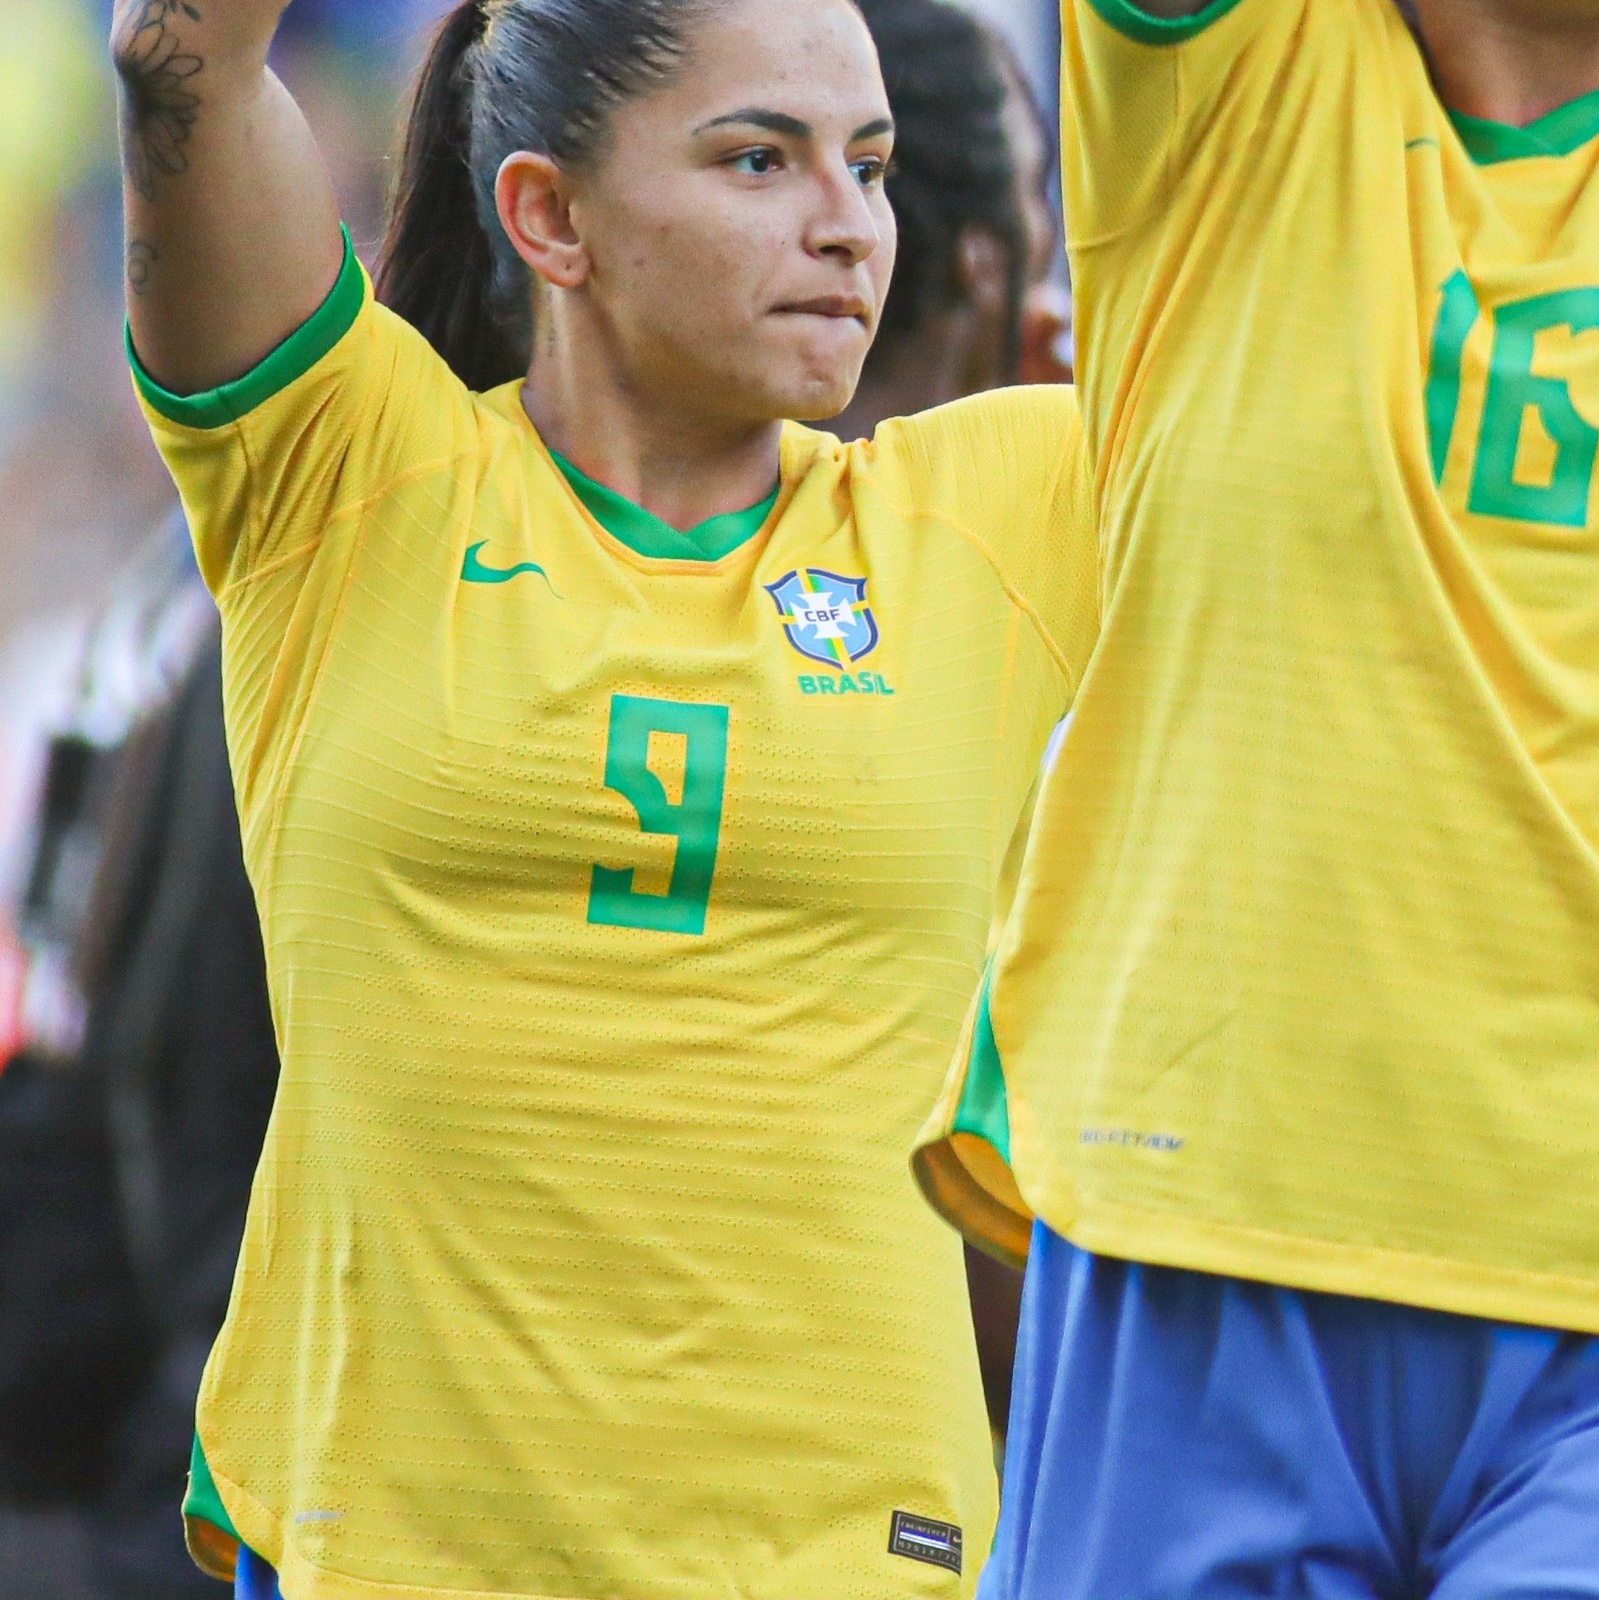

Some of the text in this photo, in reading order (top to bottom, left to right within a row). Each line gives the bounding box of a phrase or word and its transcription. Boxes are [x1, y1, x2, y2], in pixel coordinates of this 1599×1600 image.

[804, 608, 840, 623] CBF
[797, 672, 894, 696] BRASIL
[587, 694, 729, 935] 9
